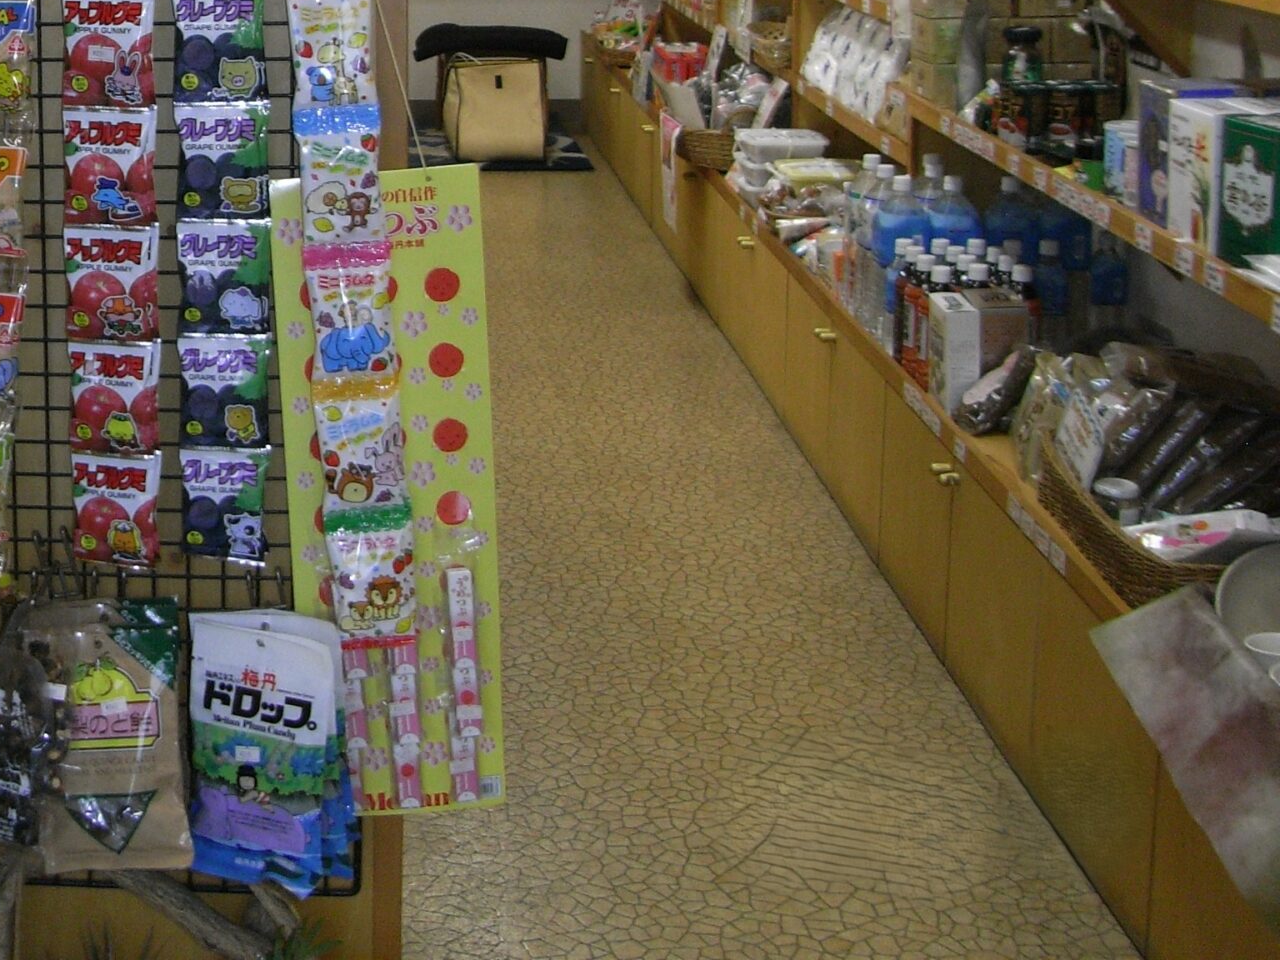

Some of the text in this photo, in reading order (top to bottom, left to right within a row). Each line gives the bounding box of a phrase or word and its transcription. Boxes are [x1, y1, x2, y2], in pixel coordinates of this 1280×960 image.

[64, 1, 143, 27] アップルグミ
[65, 120, 142, 147] アップルグミ
[178, 117, 256, 143] グレープグミ
[67, 238, 142, 265] アップルグミ
[180, 233, 257, 259] グレープグミ
[181, 347, 258, 373] グレープグミ
[73, 463, 148, 492] アップルグミ
[183, 459, 258, 486] グレープグミ
[242, 668, 277, 692] 梅丹
